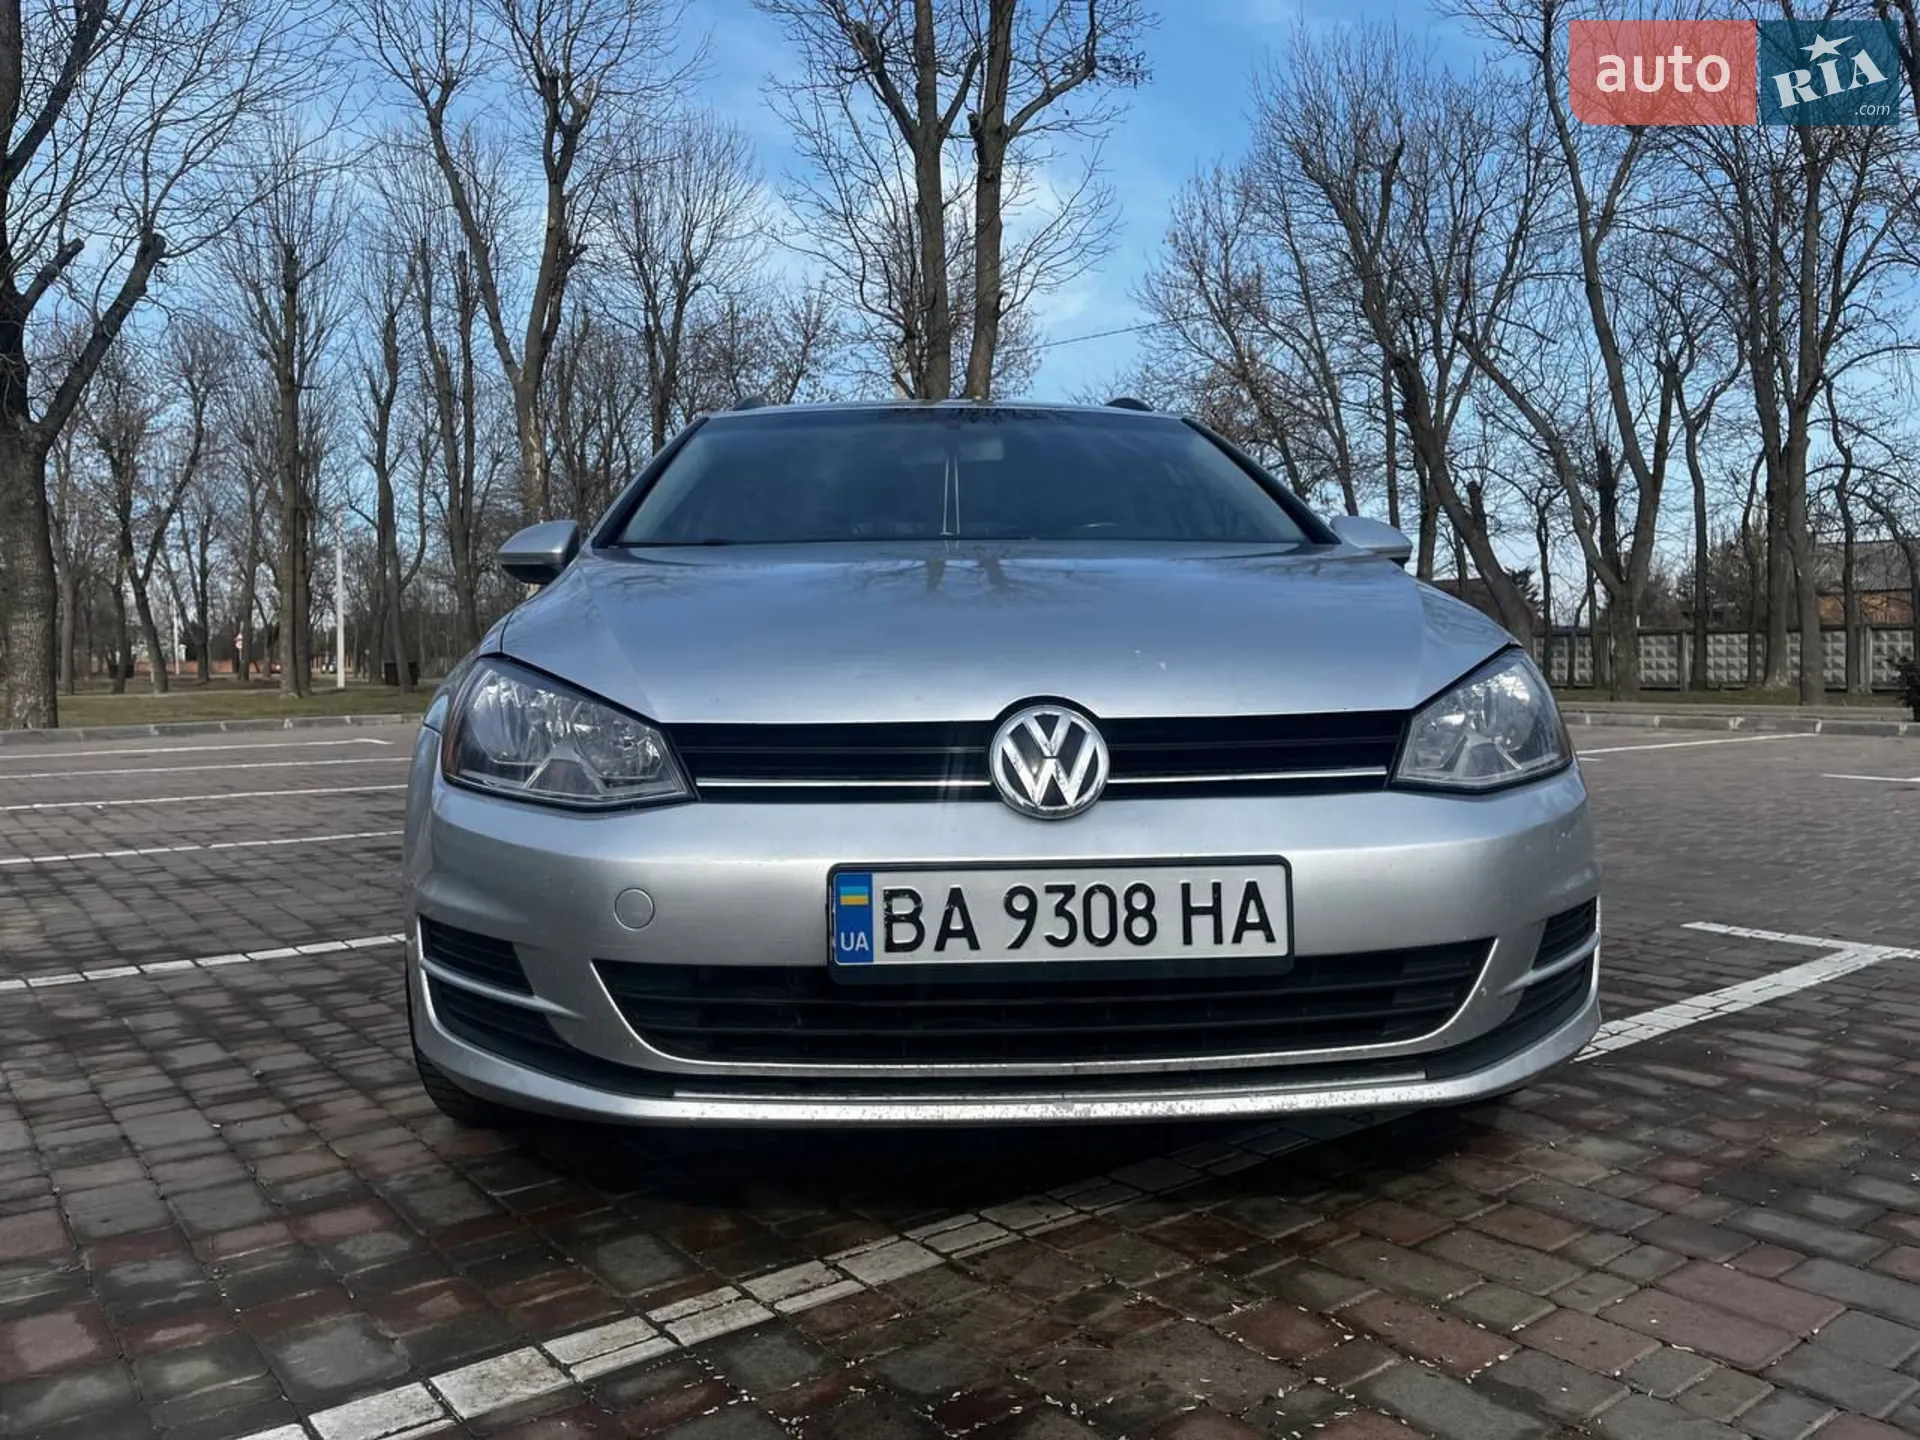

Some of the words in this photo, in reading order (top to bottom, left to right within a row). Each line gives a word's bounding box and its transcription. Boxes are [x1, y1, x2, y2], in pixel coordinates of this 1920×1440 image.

[882, 886, 981, 953] BA
[1003, 881, 1158, 950] 9308
[1181, 880, 1277, 946] HA
[840, 932, 869, 952] UA
